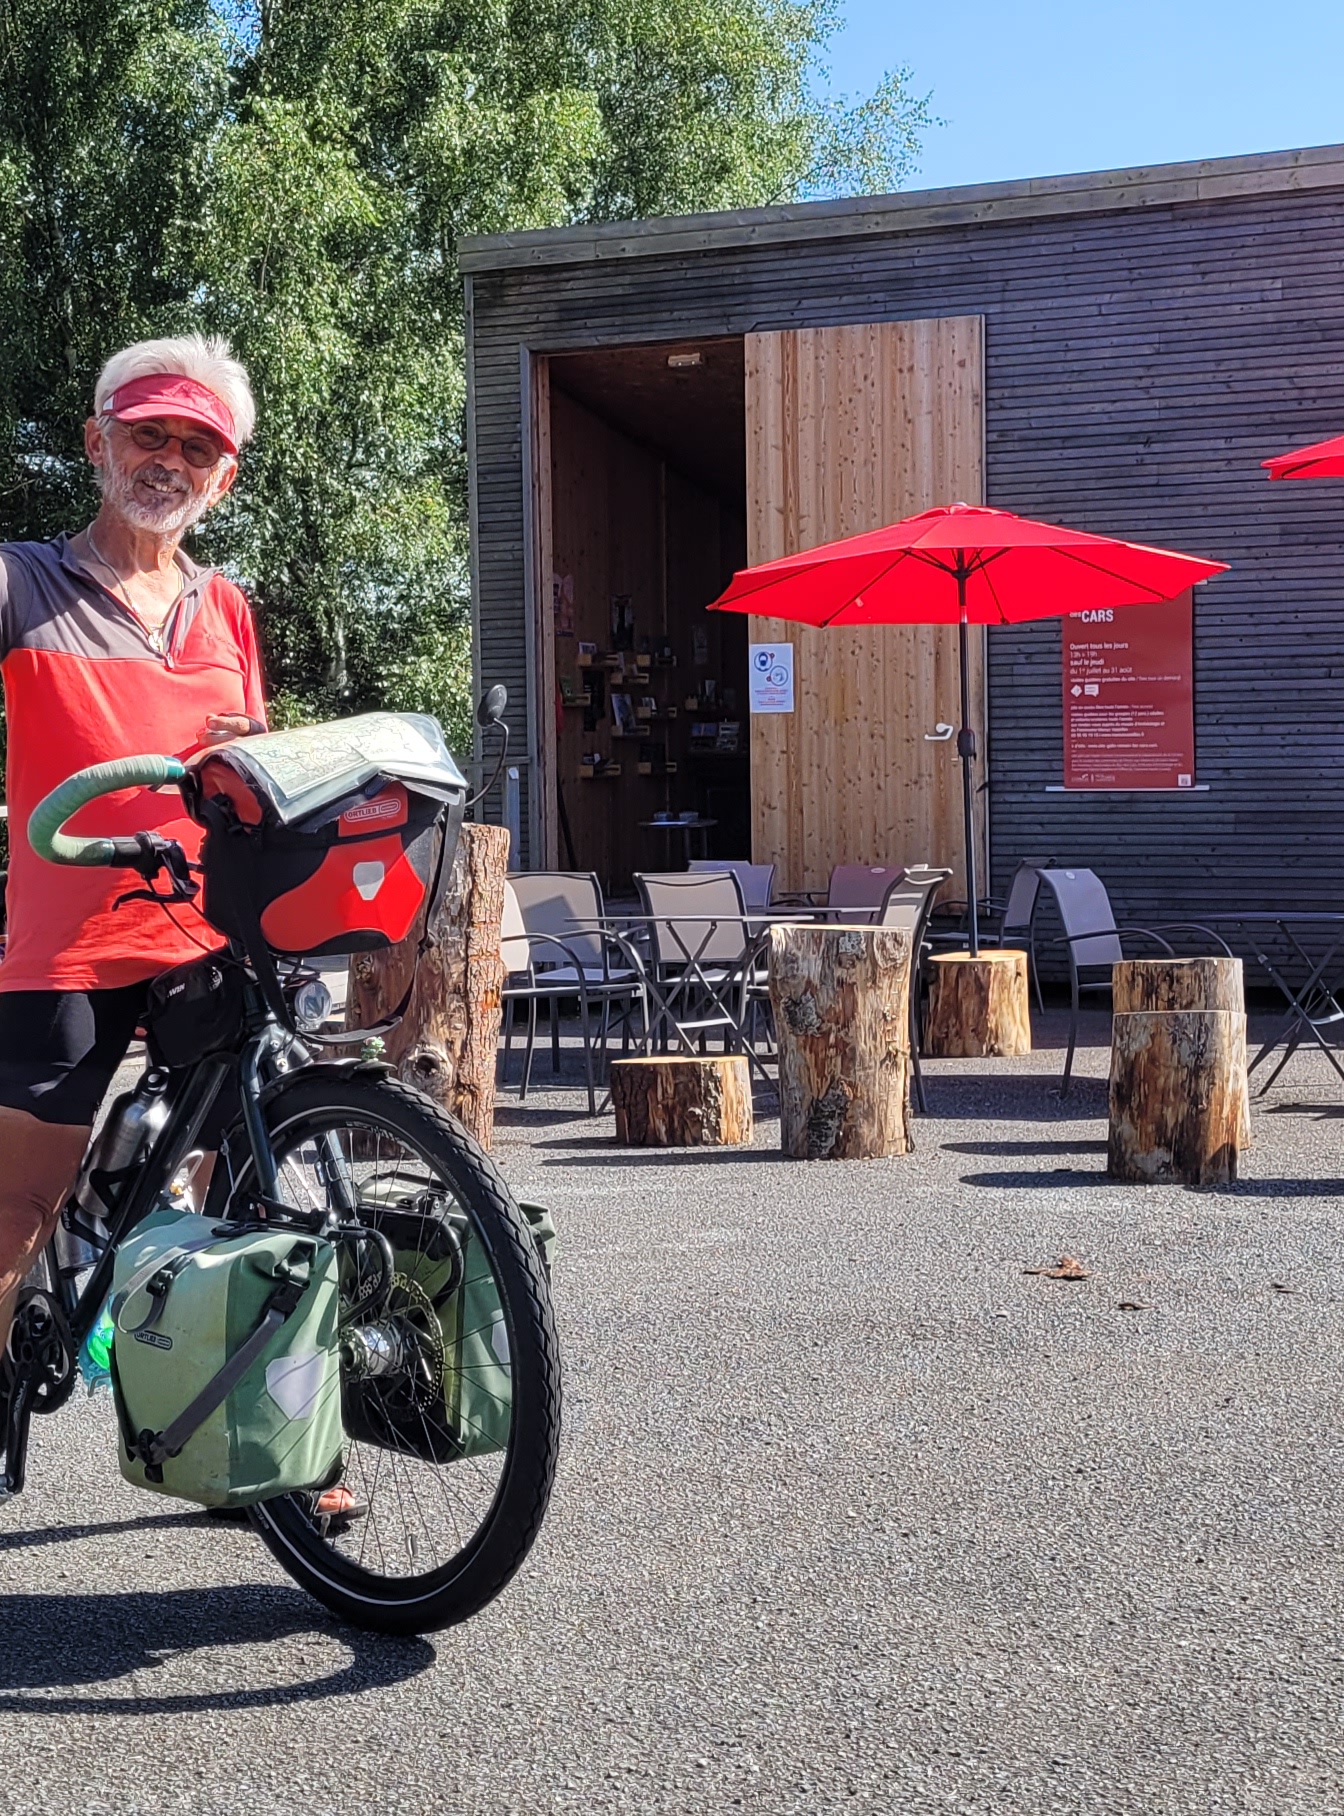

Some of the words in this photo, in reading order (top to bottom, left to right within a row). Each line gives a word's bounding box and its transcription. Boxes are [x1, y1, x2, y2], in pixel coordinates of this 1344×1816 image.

[1081, 609, 1114, 623] CARS
[1069, 642, 1089, 650] Ouvert
[1113, 642, 1129, 650] jours
[347, 807, 377, 818] ORTLIEB
[167, 982, 186, 998] WIN
